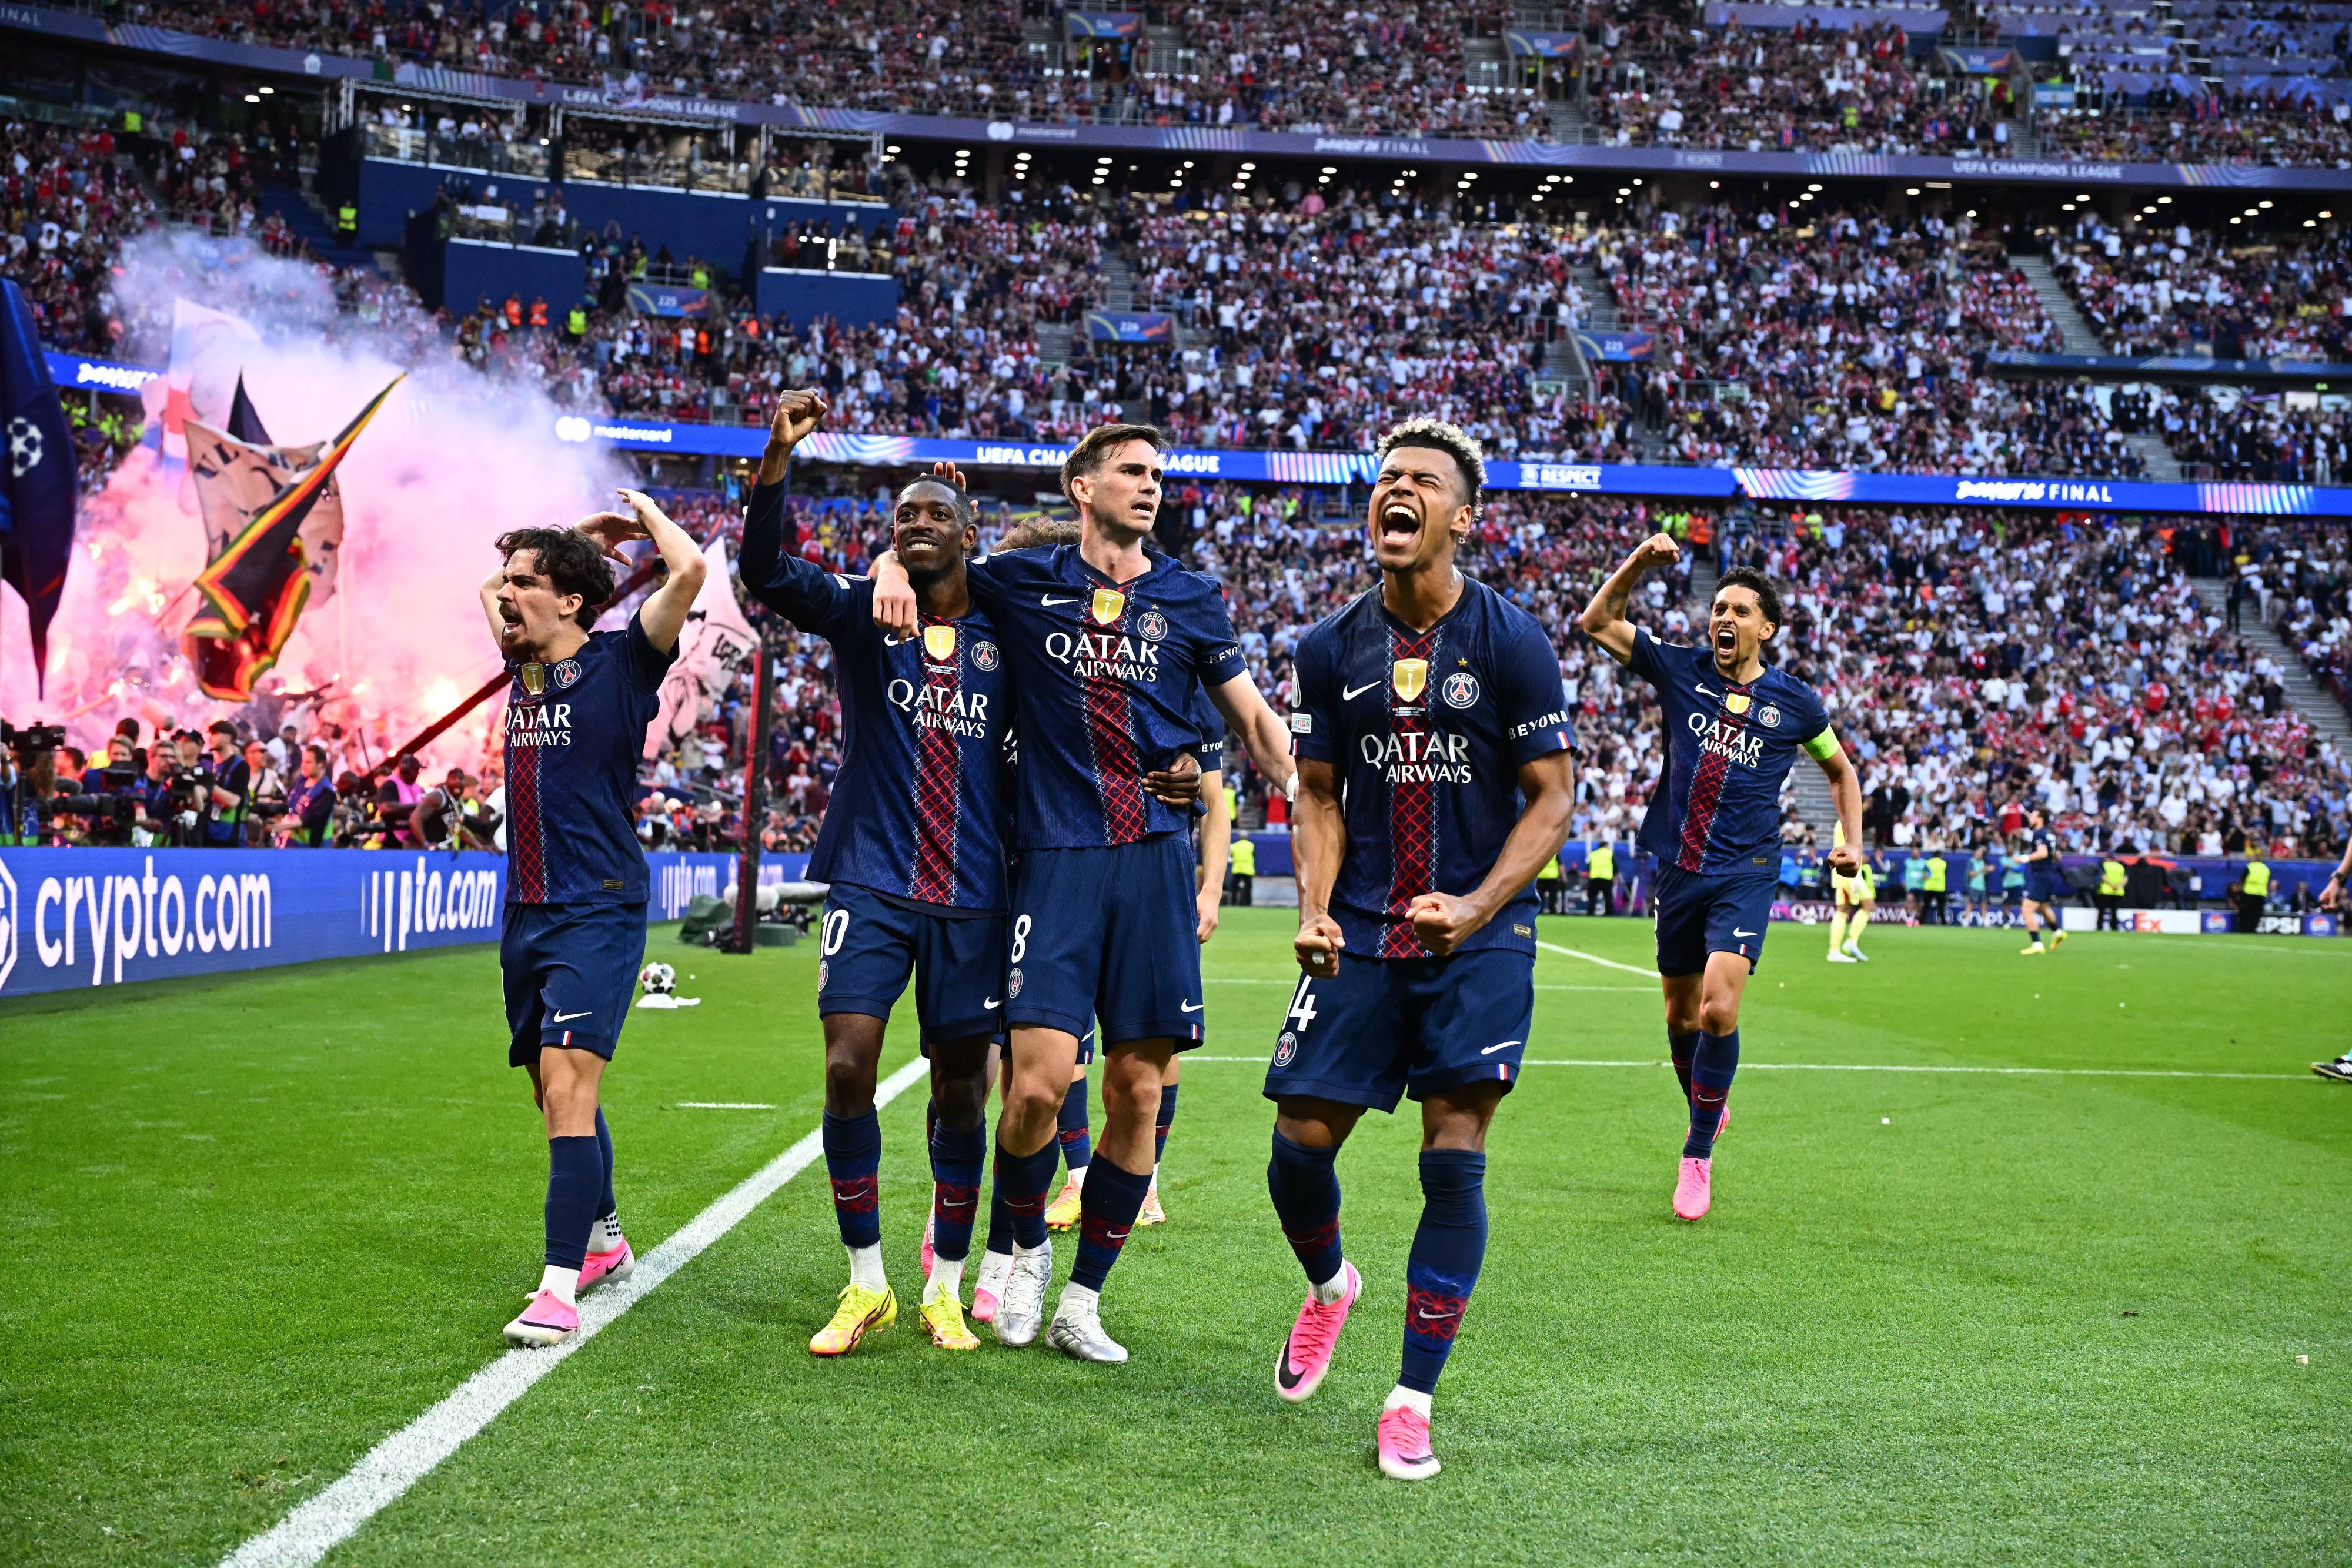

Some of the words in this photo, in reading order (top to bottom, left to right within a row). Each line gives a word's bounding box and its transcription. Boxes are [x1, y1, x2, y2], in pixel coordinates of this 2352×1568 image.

[1382, 140, 1431, 156] FINAL
[1953, 160, 1989, 174] UEFA
[1990, 161, 2069, 177] CHAMPIONS
[2071, 164, 2122, 179] LEAGUE
[594, 426, 672, 442] mastercard
[977, 446, 1026, 464] UEFA
[1158, 454, 1220, 473] EAGUE
[2049, 483, 2113, 503] FINAL
[1144, 613, 1164, 623] PARIS
[976, 643, 995, 652] PARIS
[1045, 632, 1160, 665] QATAR
[557, 661, 575, 671] PARIS
[1073, 660, 1158, 683] AIRWAYS
[1450, 674, 1474, 684] PARIS
[887, 678, 988, 721] QATAR
[911, 710, 986, 739] AIRWAYS
[1508, 710, 1568, 740] BEYOND
[510, 731, 572, 747] AIRWAYS
[1688, 712, 1765, 758] QATAR
[1361, 731, 1471, 770] QATAR
[1699, 737, 1758, 769] AIRWAYS
[1385, 764, 1471, 784] AIRWAYS
[35, 855, 272, 985] crypto.com
[1790, 904, 1836, 921] QATA
[820, 909, 850, 959] 10
[1011, 914, 1032, 964] 8
[1282, 975, 1317, 1032] 4
[1281, 1034, 1294, 1043] PARIS
